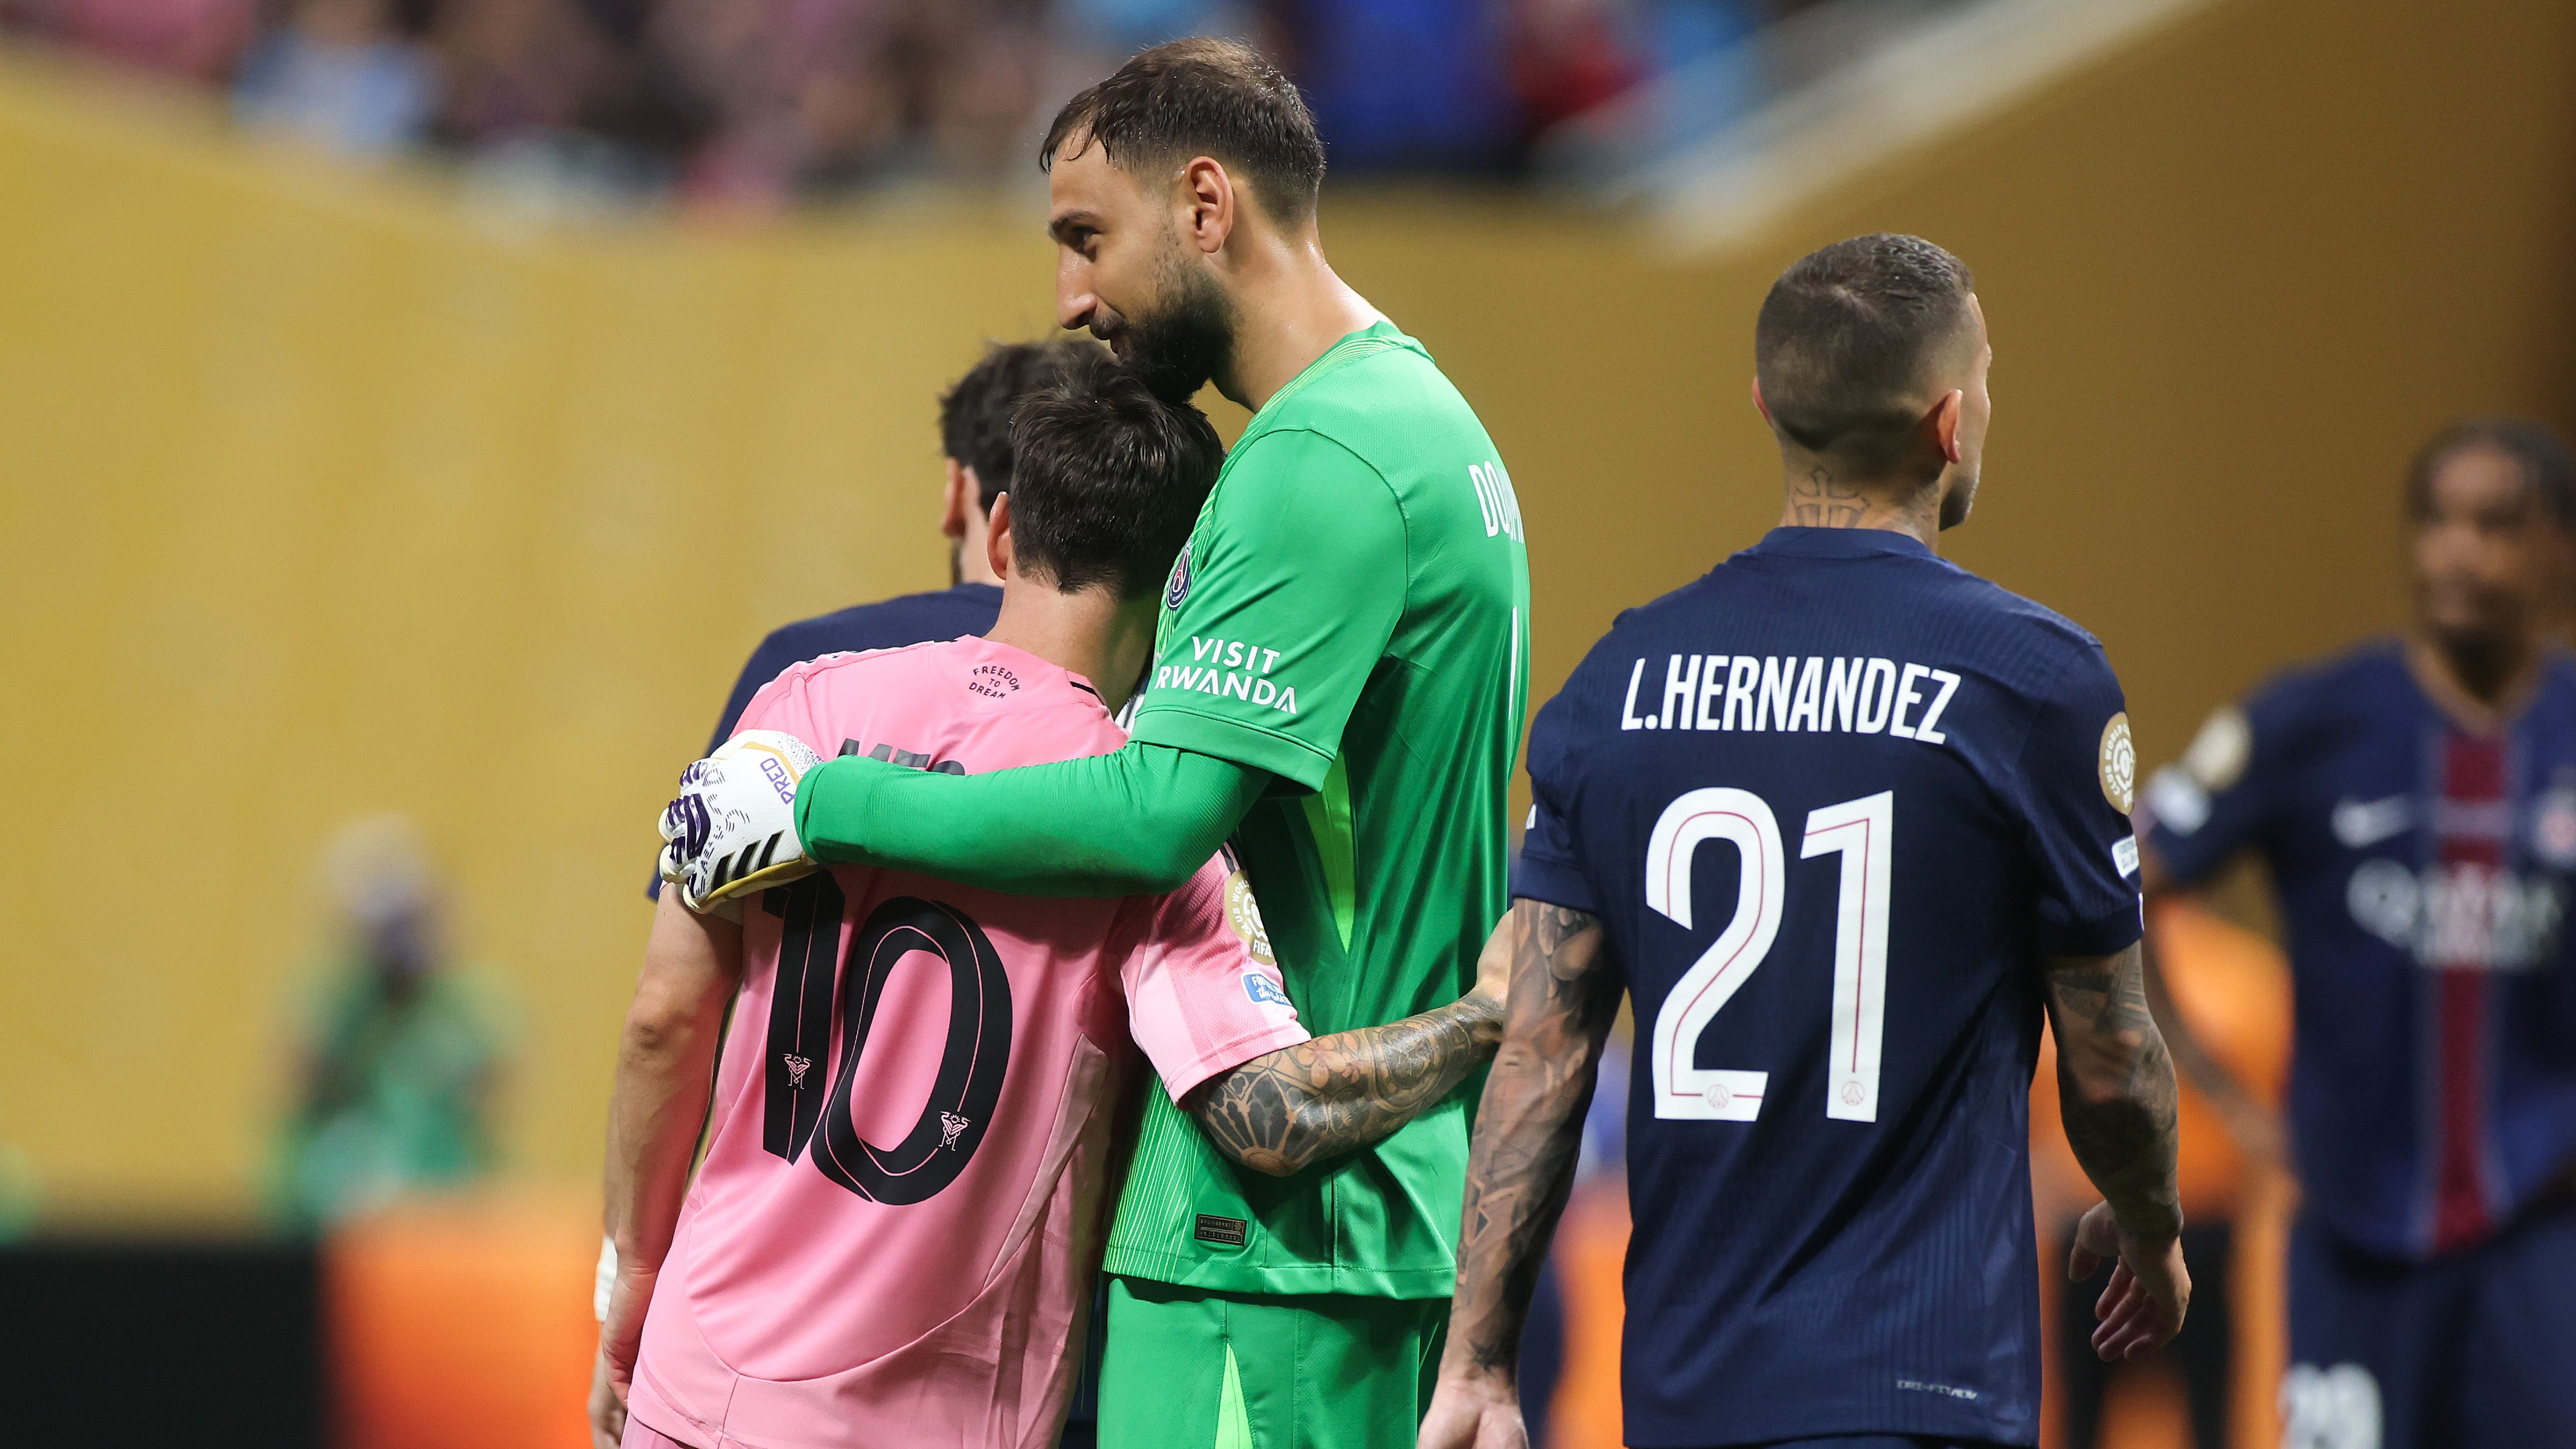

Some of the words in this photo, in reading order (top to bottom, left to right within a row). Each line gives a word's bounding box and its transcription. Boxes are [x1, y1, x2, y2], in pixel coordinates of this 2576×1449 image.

[1192, 636, 1281, 674] VISIT
[969, 682, 1006, 699] DREAM
[973, 666, 1020, 691] FREEDOM
[989, 678, 1001, 687] TO
[1153, 666, 1298, 714] RWANDA
[1621, 654, 1962, 745] L.HERNANDEZ
[760, 758, 795, 805] PRED
[1232, 907, 1252, 935] CLUB
[1253, 938, 1273, 958] FIFA
[1646, 787, 1893, 1123] 21
[762, 870, 1013, 1205] 10
